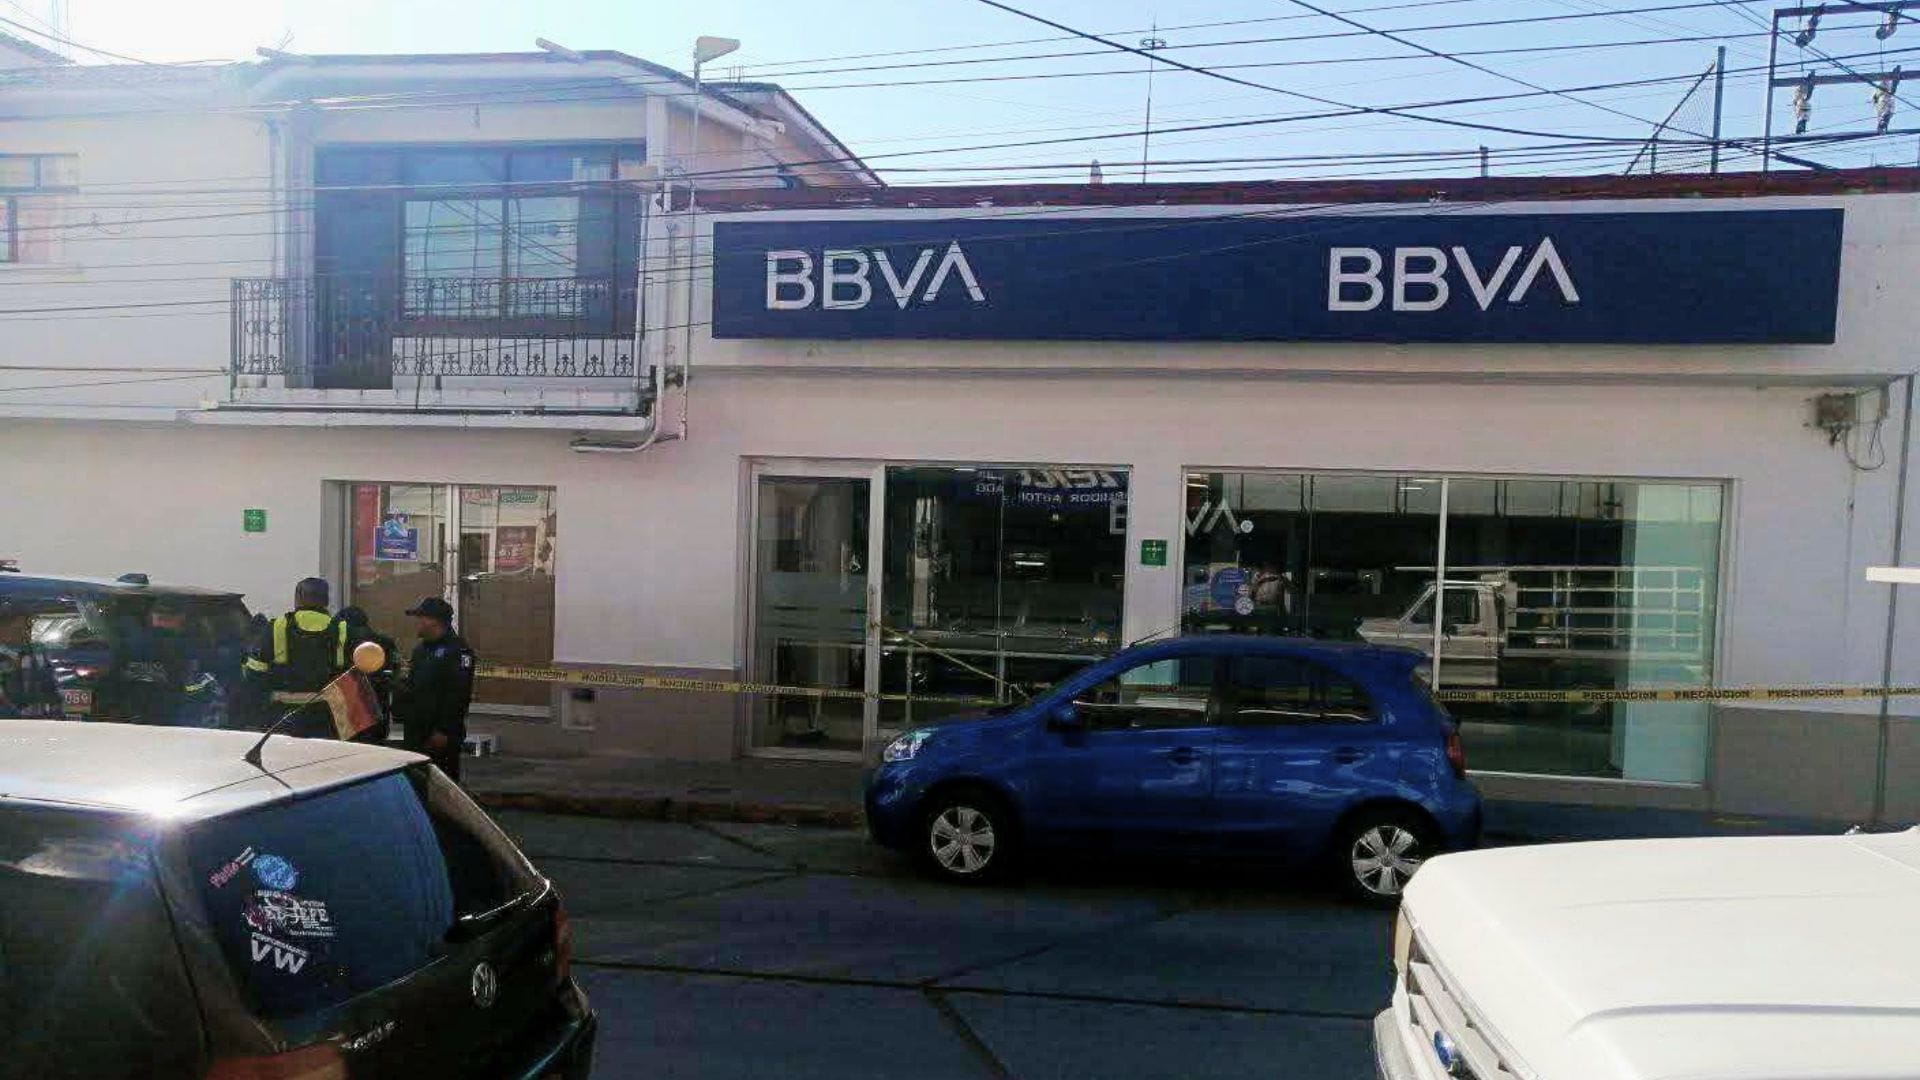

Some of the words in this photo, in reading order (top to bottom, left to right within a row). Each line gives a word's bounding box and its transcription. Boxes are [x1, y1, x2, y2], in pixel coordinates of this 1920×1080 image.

[767, 240, 985, 310] BBVA
[1328, 236, 1580, 311] BBVA
[1434, 691, 1477, 701] AUCION
[1491, 690, 1567, 701] PRECAUCION
[1582, 690, 1658, 701] PRECAUCION
[1673, 690, 1750, 700] PRECAUCION
[1766, 689, 1845, 698] PRECAUCION
[251, 938, 307, 975] VW
